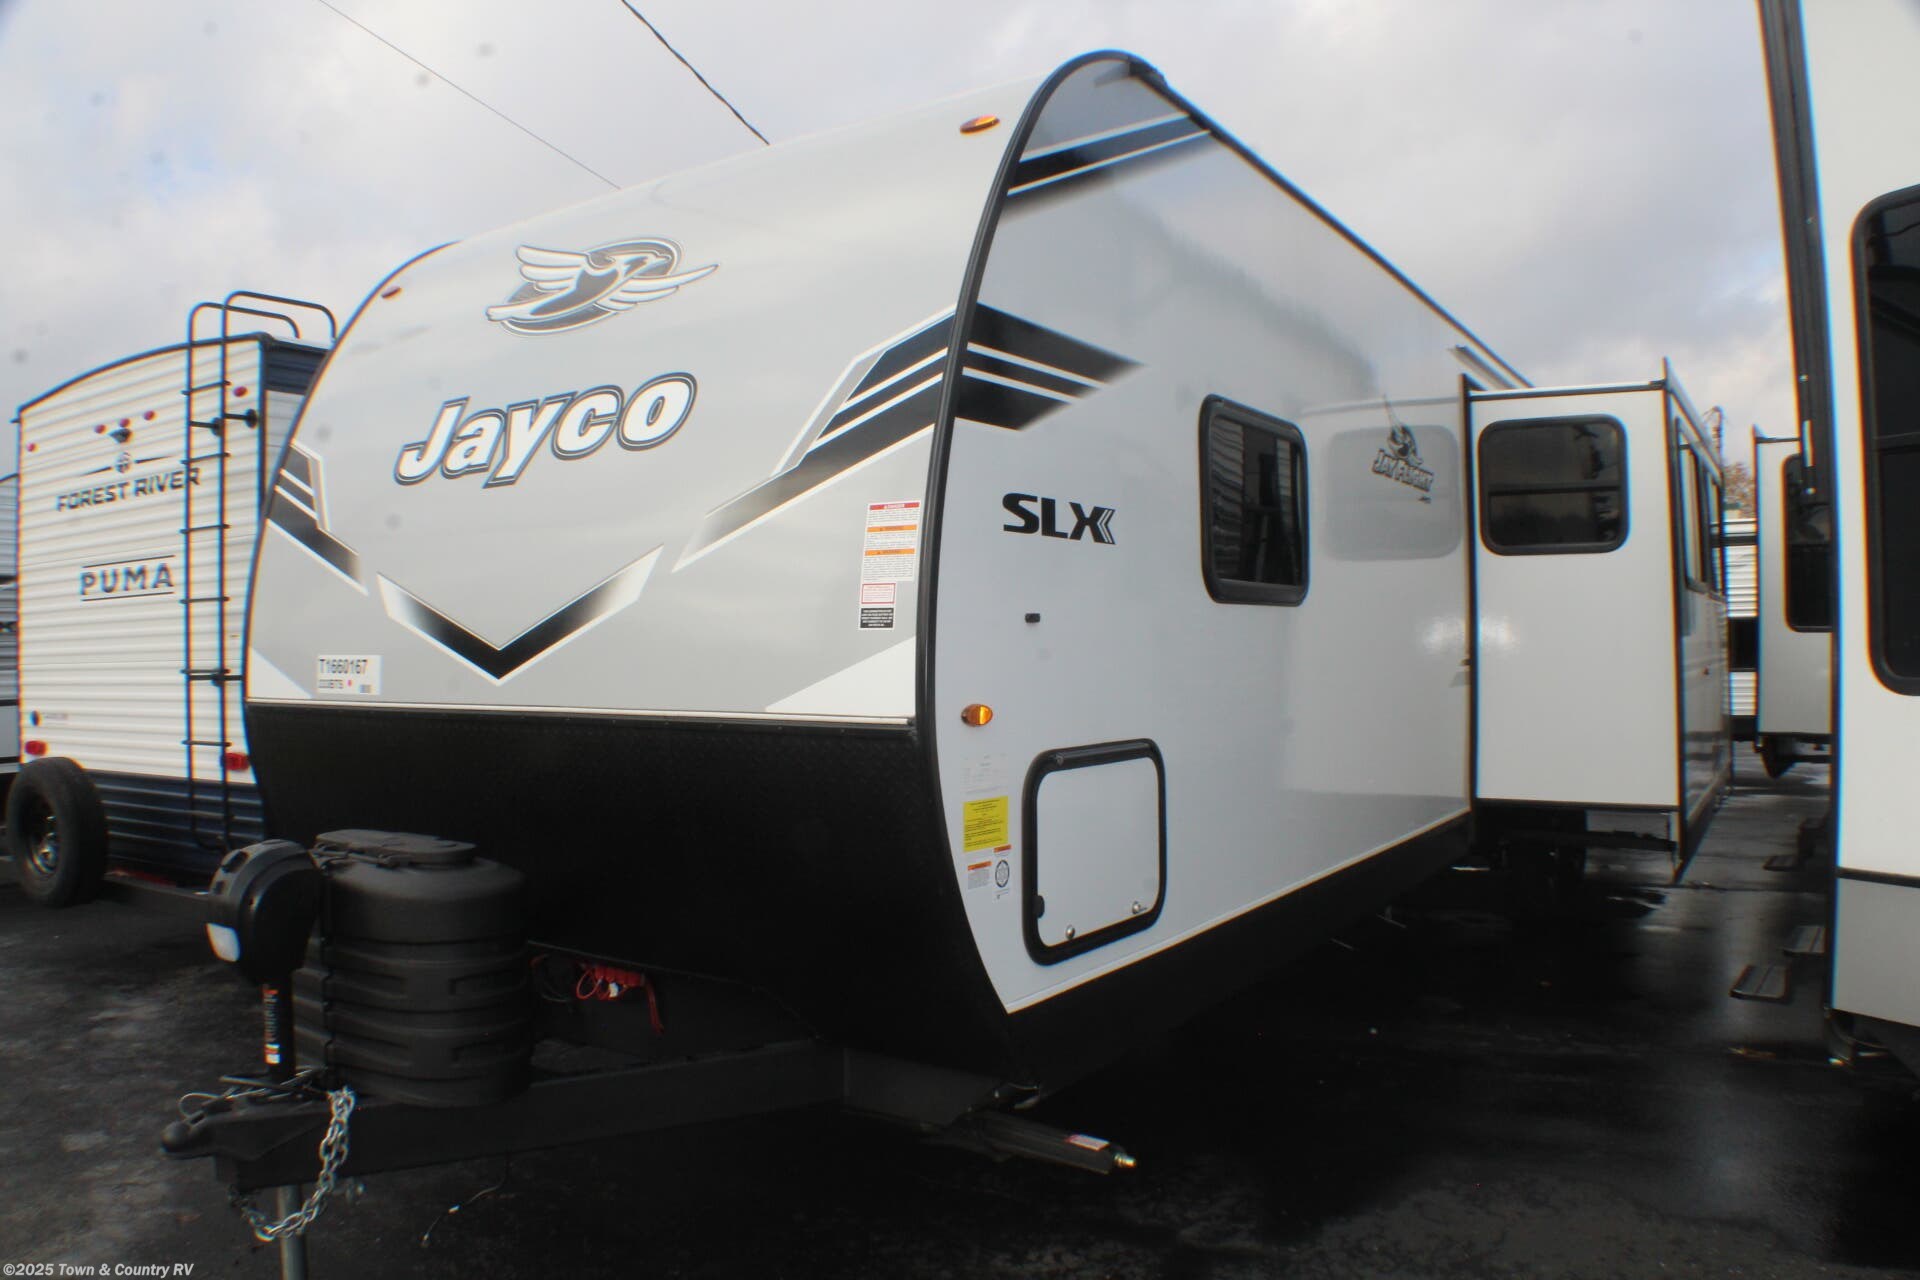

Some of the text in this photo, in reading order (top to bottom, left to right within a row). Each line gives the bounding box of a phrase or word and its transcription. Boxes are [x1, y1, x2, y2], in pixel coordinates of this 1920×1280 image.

[393, 372, 698, 489] Jayco
[55, 466, 201, 513] FOREST RIVER
[1002, 492, 1116, 545] SLX
[79, 562, 175, 595] PUMA
[319, 658, 368, 674] T1660167
